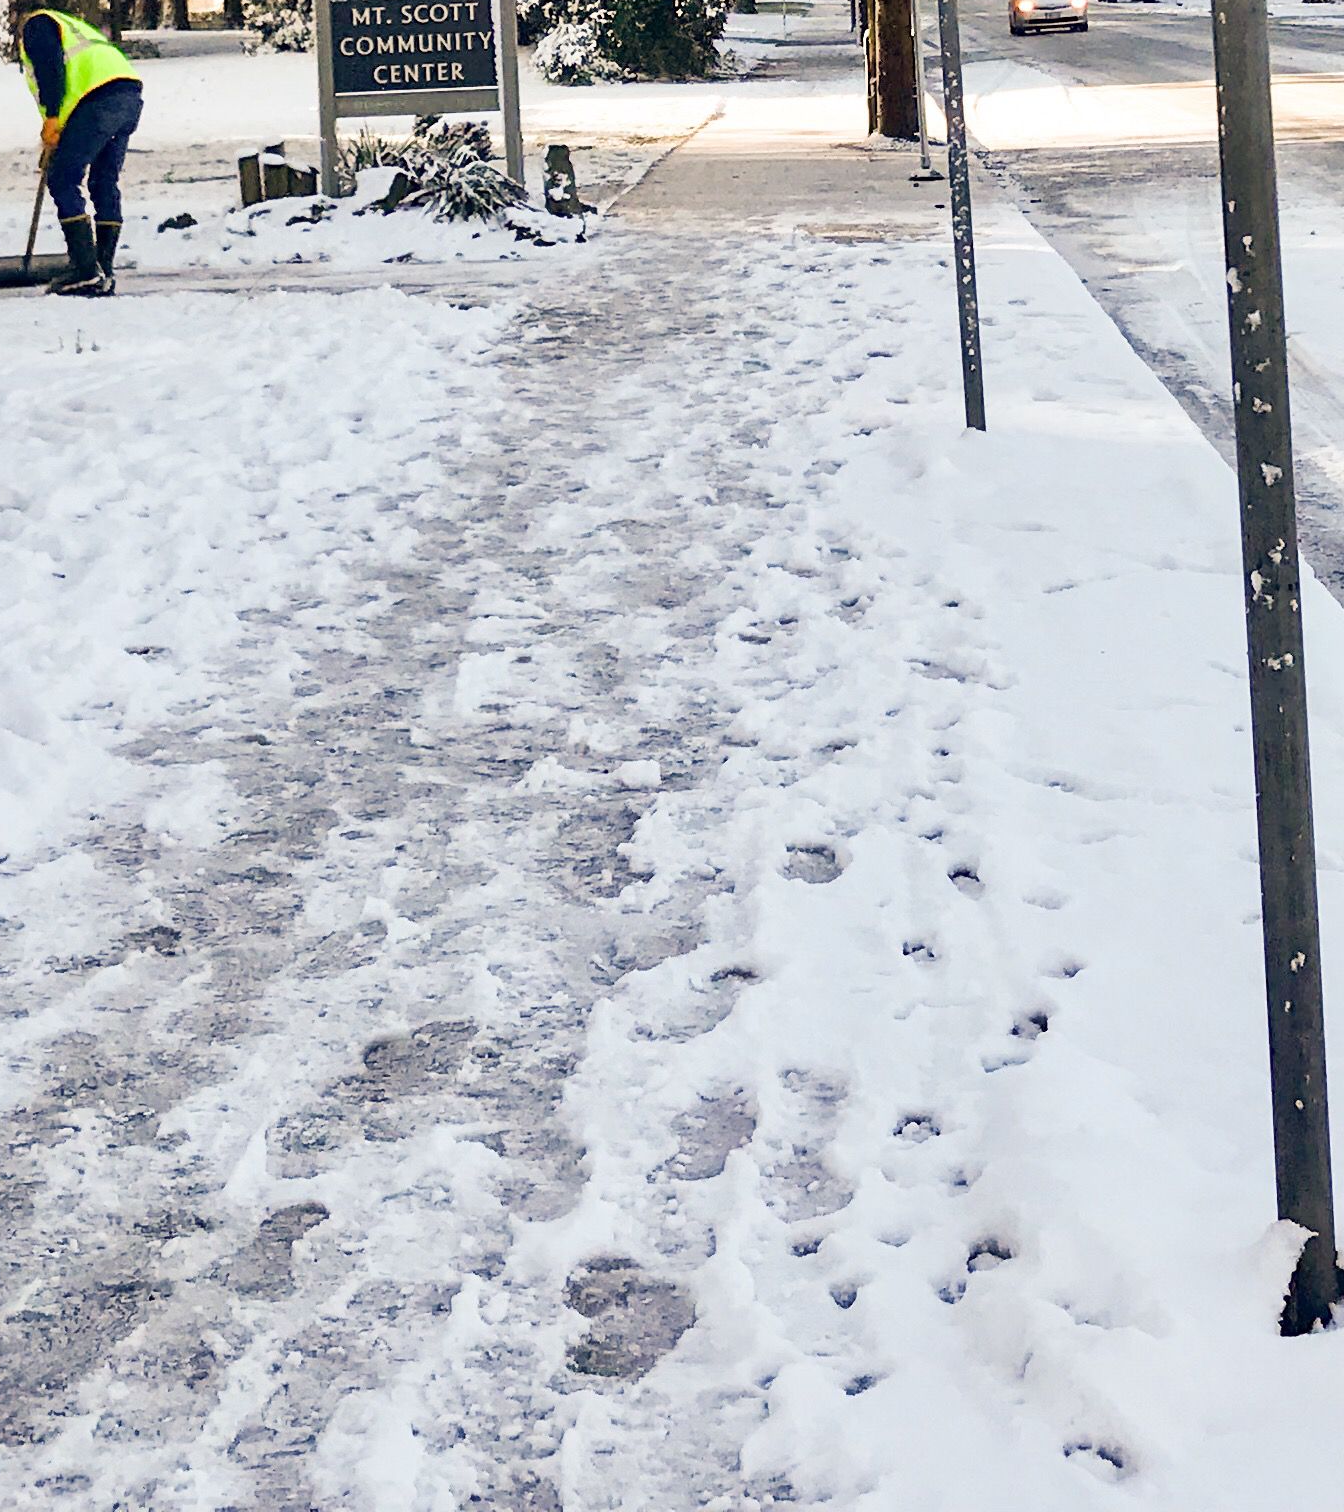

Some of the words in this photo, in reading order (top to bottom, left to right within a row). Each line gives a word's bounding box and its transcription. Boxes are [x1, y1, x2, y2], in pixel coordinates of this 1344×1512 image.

[351, 6, 392, 26] MT.
[401, 2, 479, 24] SCOTT
[340, 31, 492, 56] COMMUNITY
[373, 62, 465, 85] CENTER
